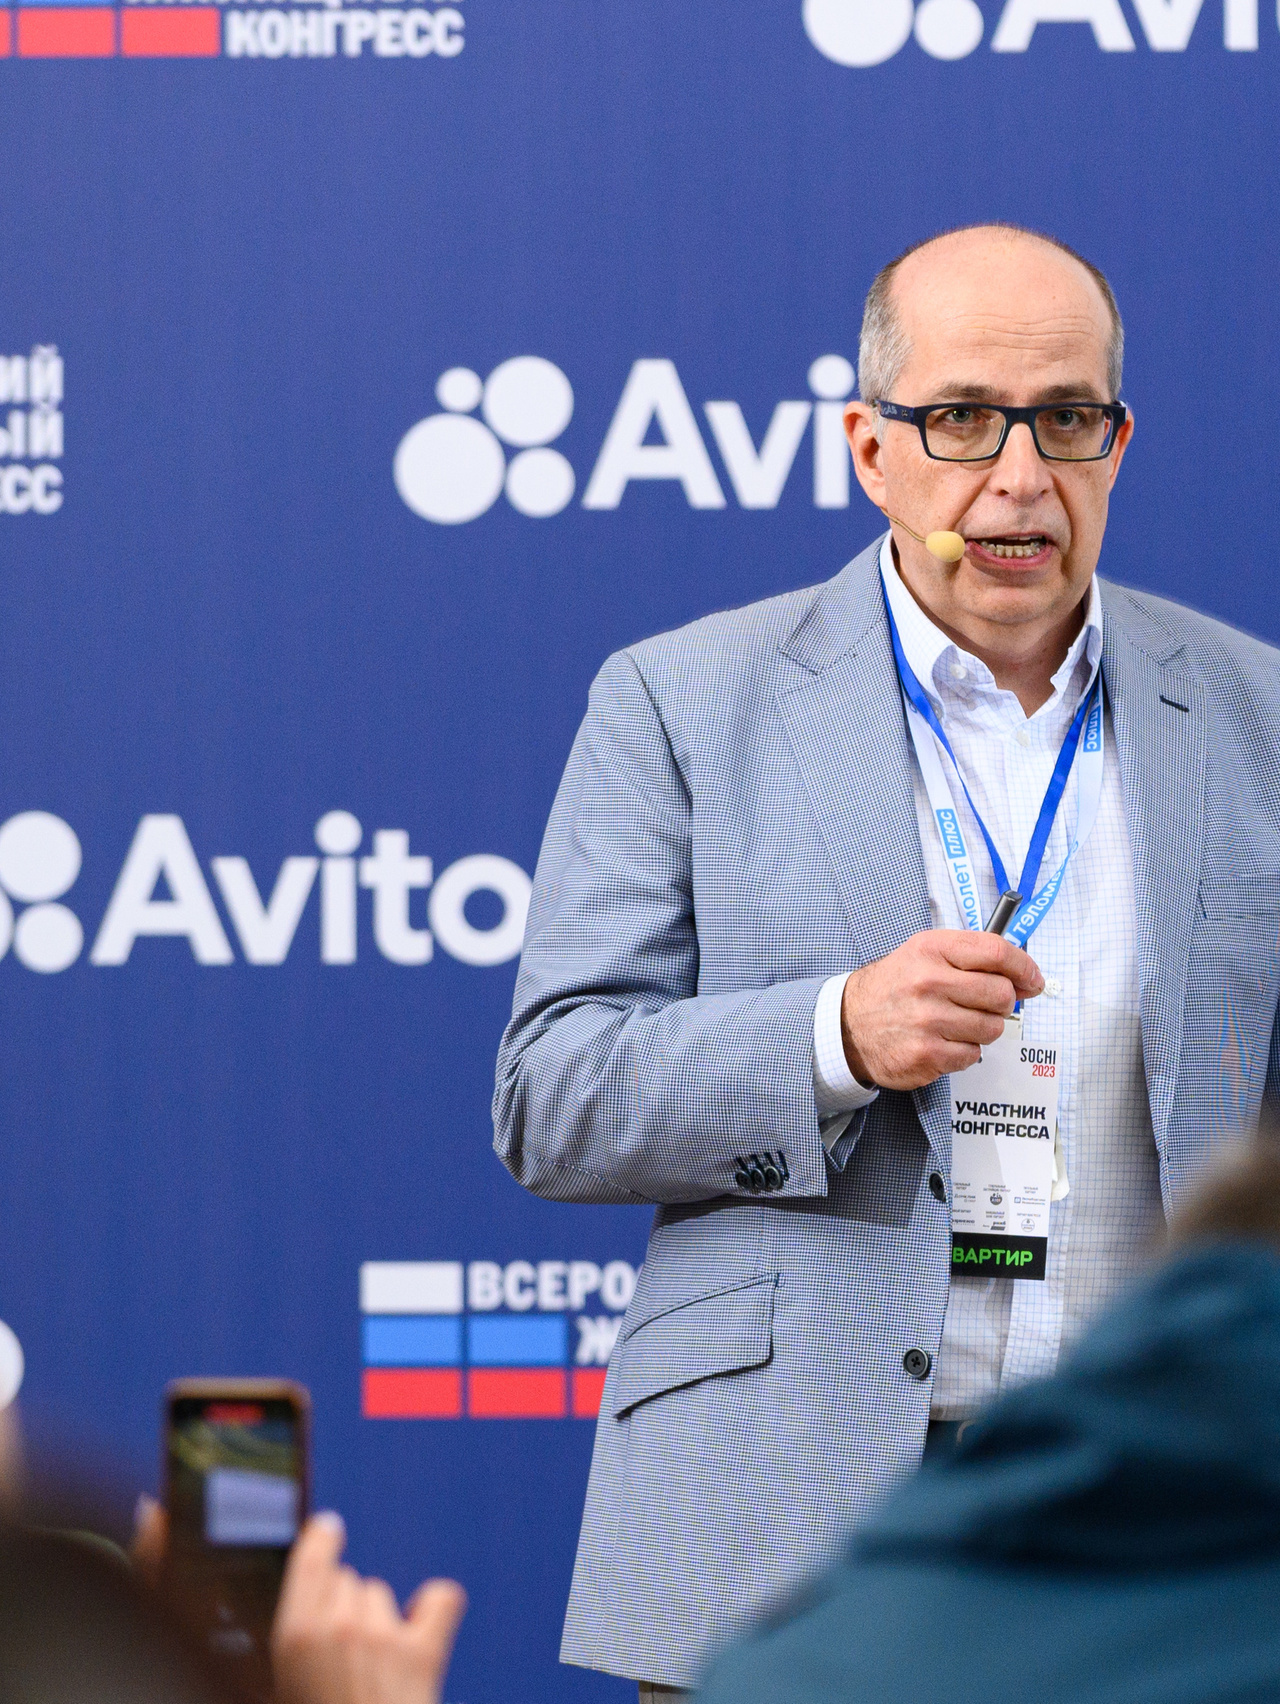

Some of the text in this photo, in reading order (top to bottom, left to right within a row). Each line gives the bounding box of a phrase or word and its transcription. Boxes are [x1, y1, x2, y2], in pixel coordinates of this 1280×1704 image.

[226, 8, 465, 58] КОНГРЕСС
[0, 464, 64, 514] СС
[90, 811, 533, 966] Avito
[953, 862, 980, 931] молет
[1020, 1047, 1056, 1065] SOCHI
[1032, 1064, 1056, 1078] 2023
[955, 1100, 1047, 1120] УЧАСТНИК
[951, 1119, 1050, 1140] КОНГРЕССА
[952, 1246, 1034, 1267] ВАРТИР
[467, 1261, 645, 1311] ВСЕРО
